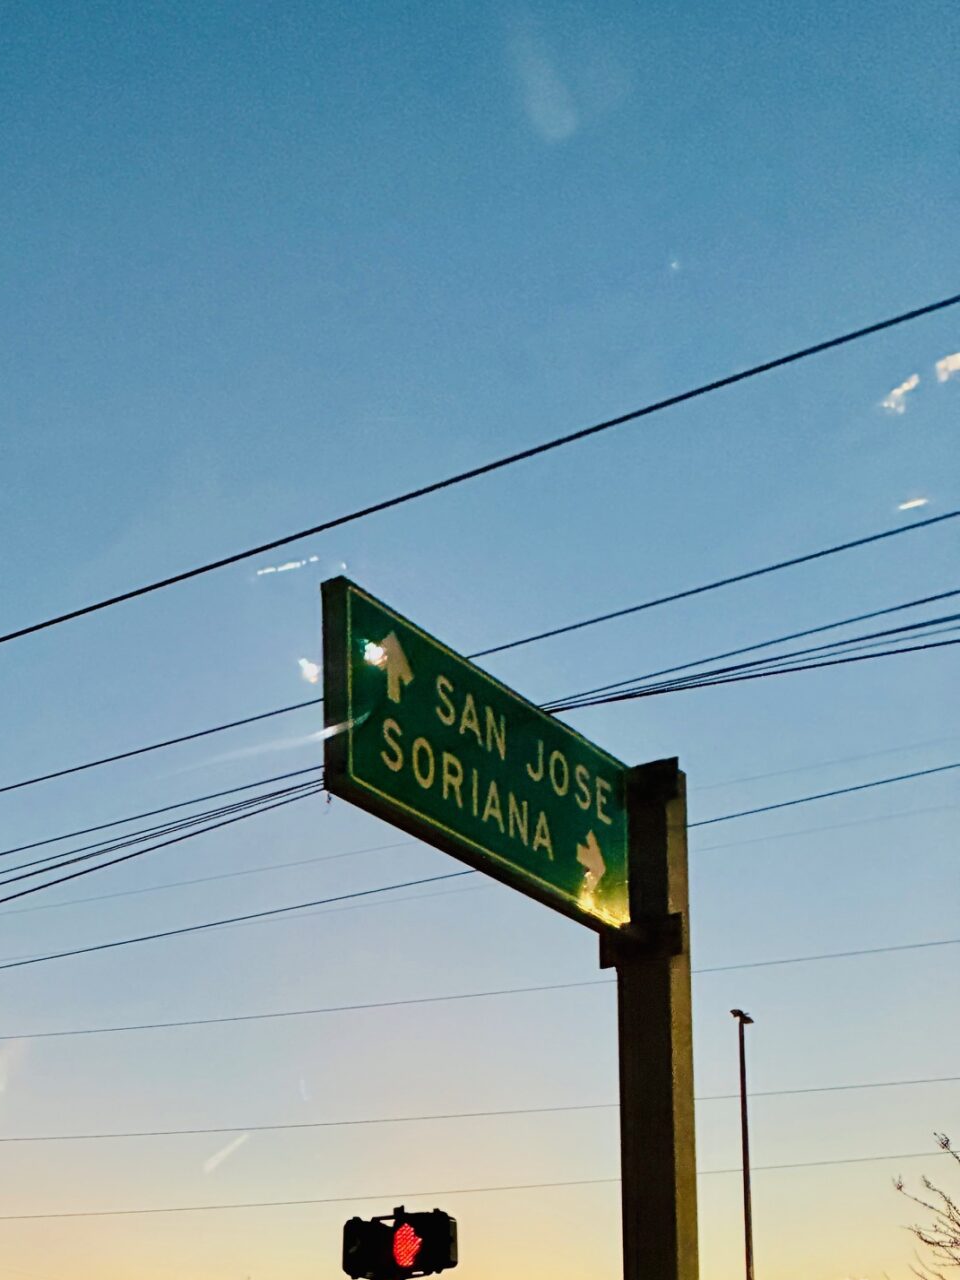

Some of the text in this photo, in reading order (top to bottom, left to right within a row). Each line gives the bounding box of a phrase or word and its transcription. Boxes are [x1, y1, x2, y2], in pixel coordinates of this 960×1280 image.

[380, 718, 555, 861] SORIANA
[435, 674, 613, 825] SAN JOSE
